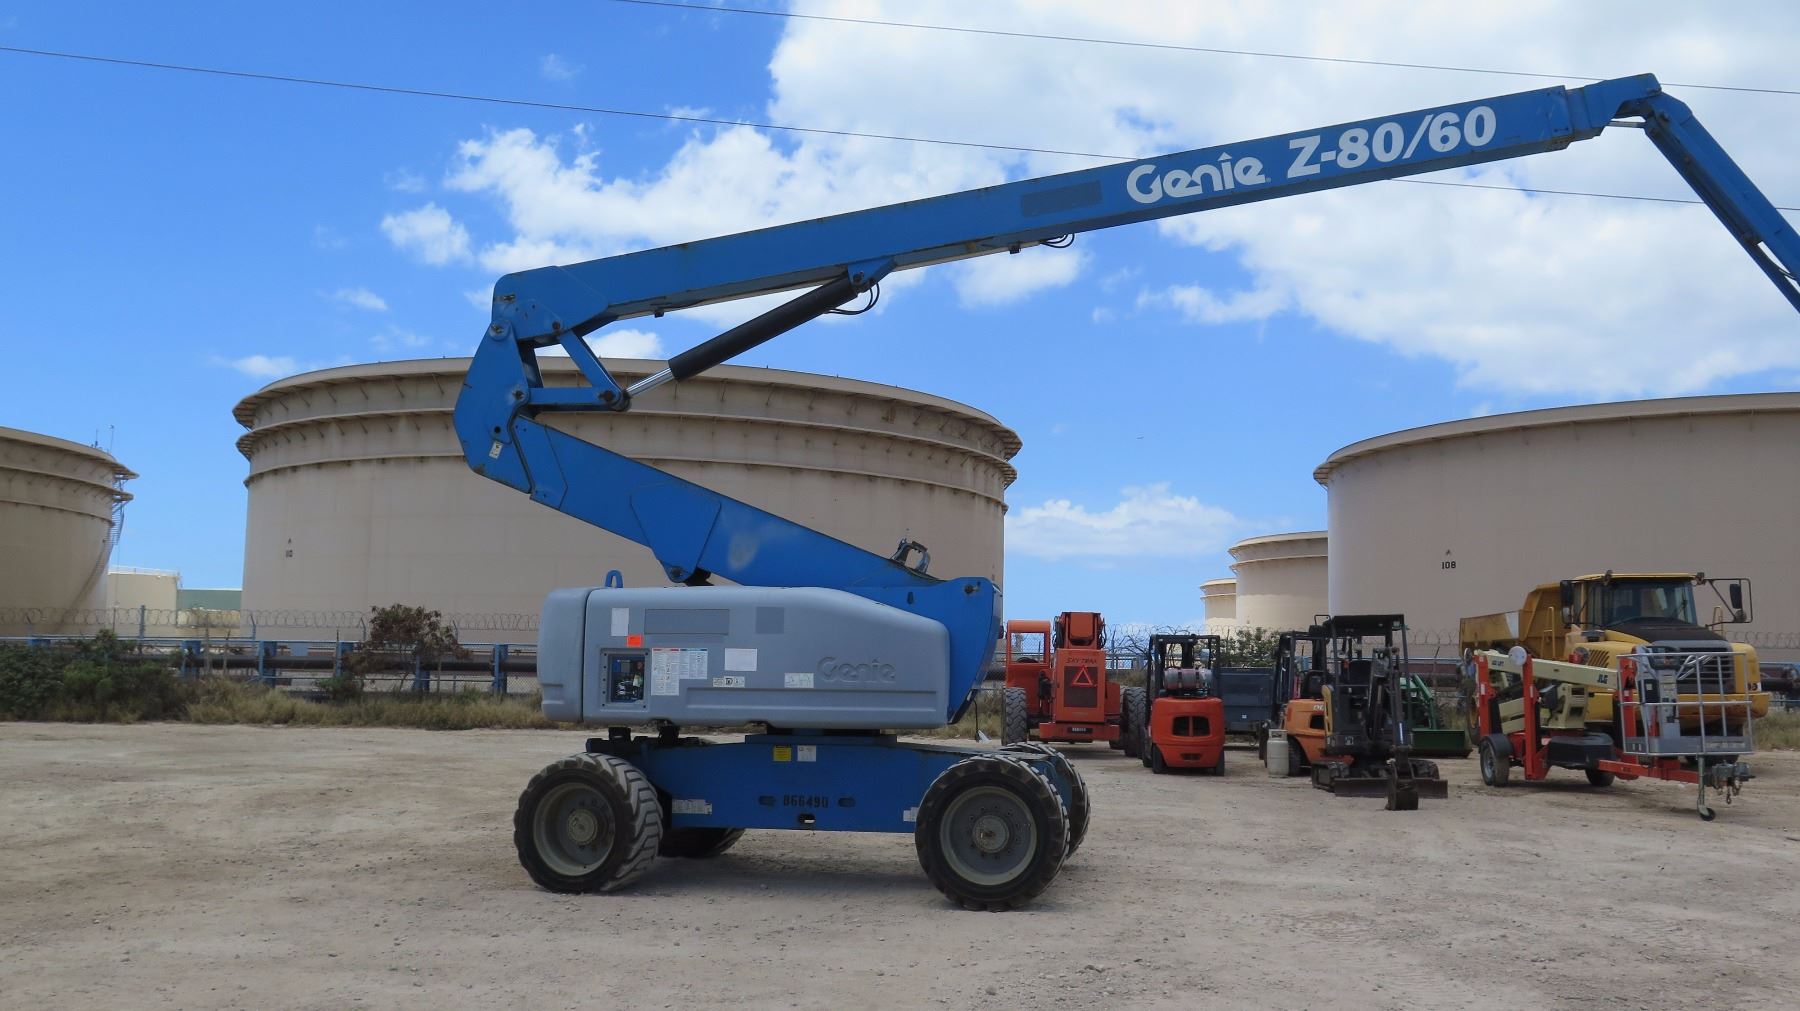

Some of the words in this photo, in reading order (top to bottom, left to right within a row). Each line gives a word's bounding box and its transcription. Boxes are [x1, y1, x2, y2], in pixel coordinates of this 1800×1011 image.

[1126, 152, 1266, 204] Genie
[1287, 105, 1497, 179] Z-80/60
[818, 656, 896, 683] Genie
